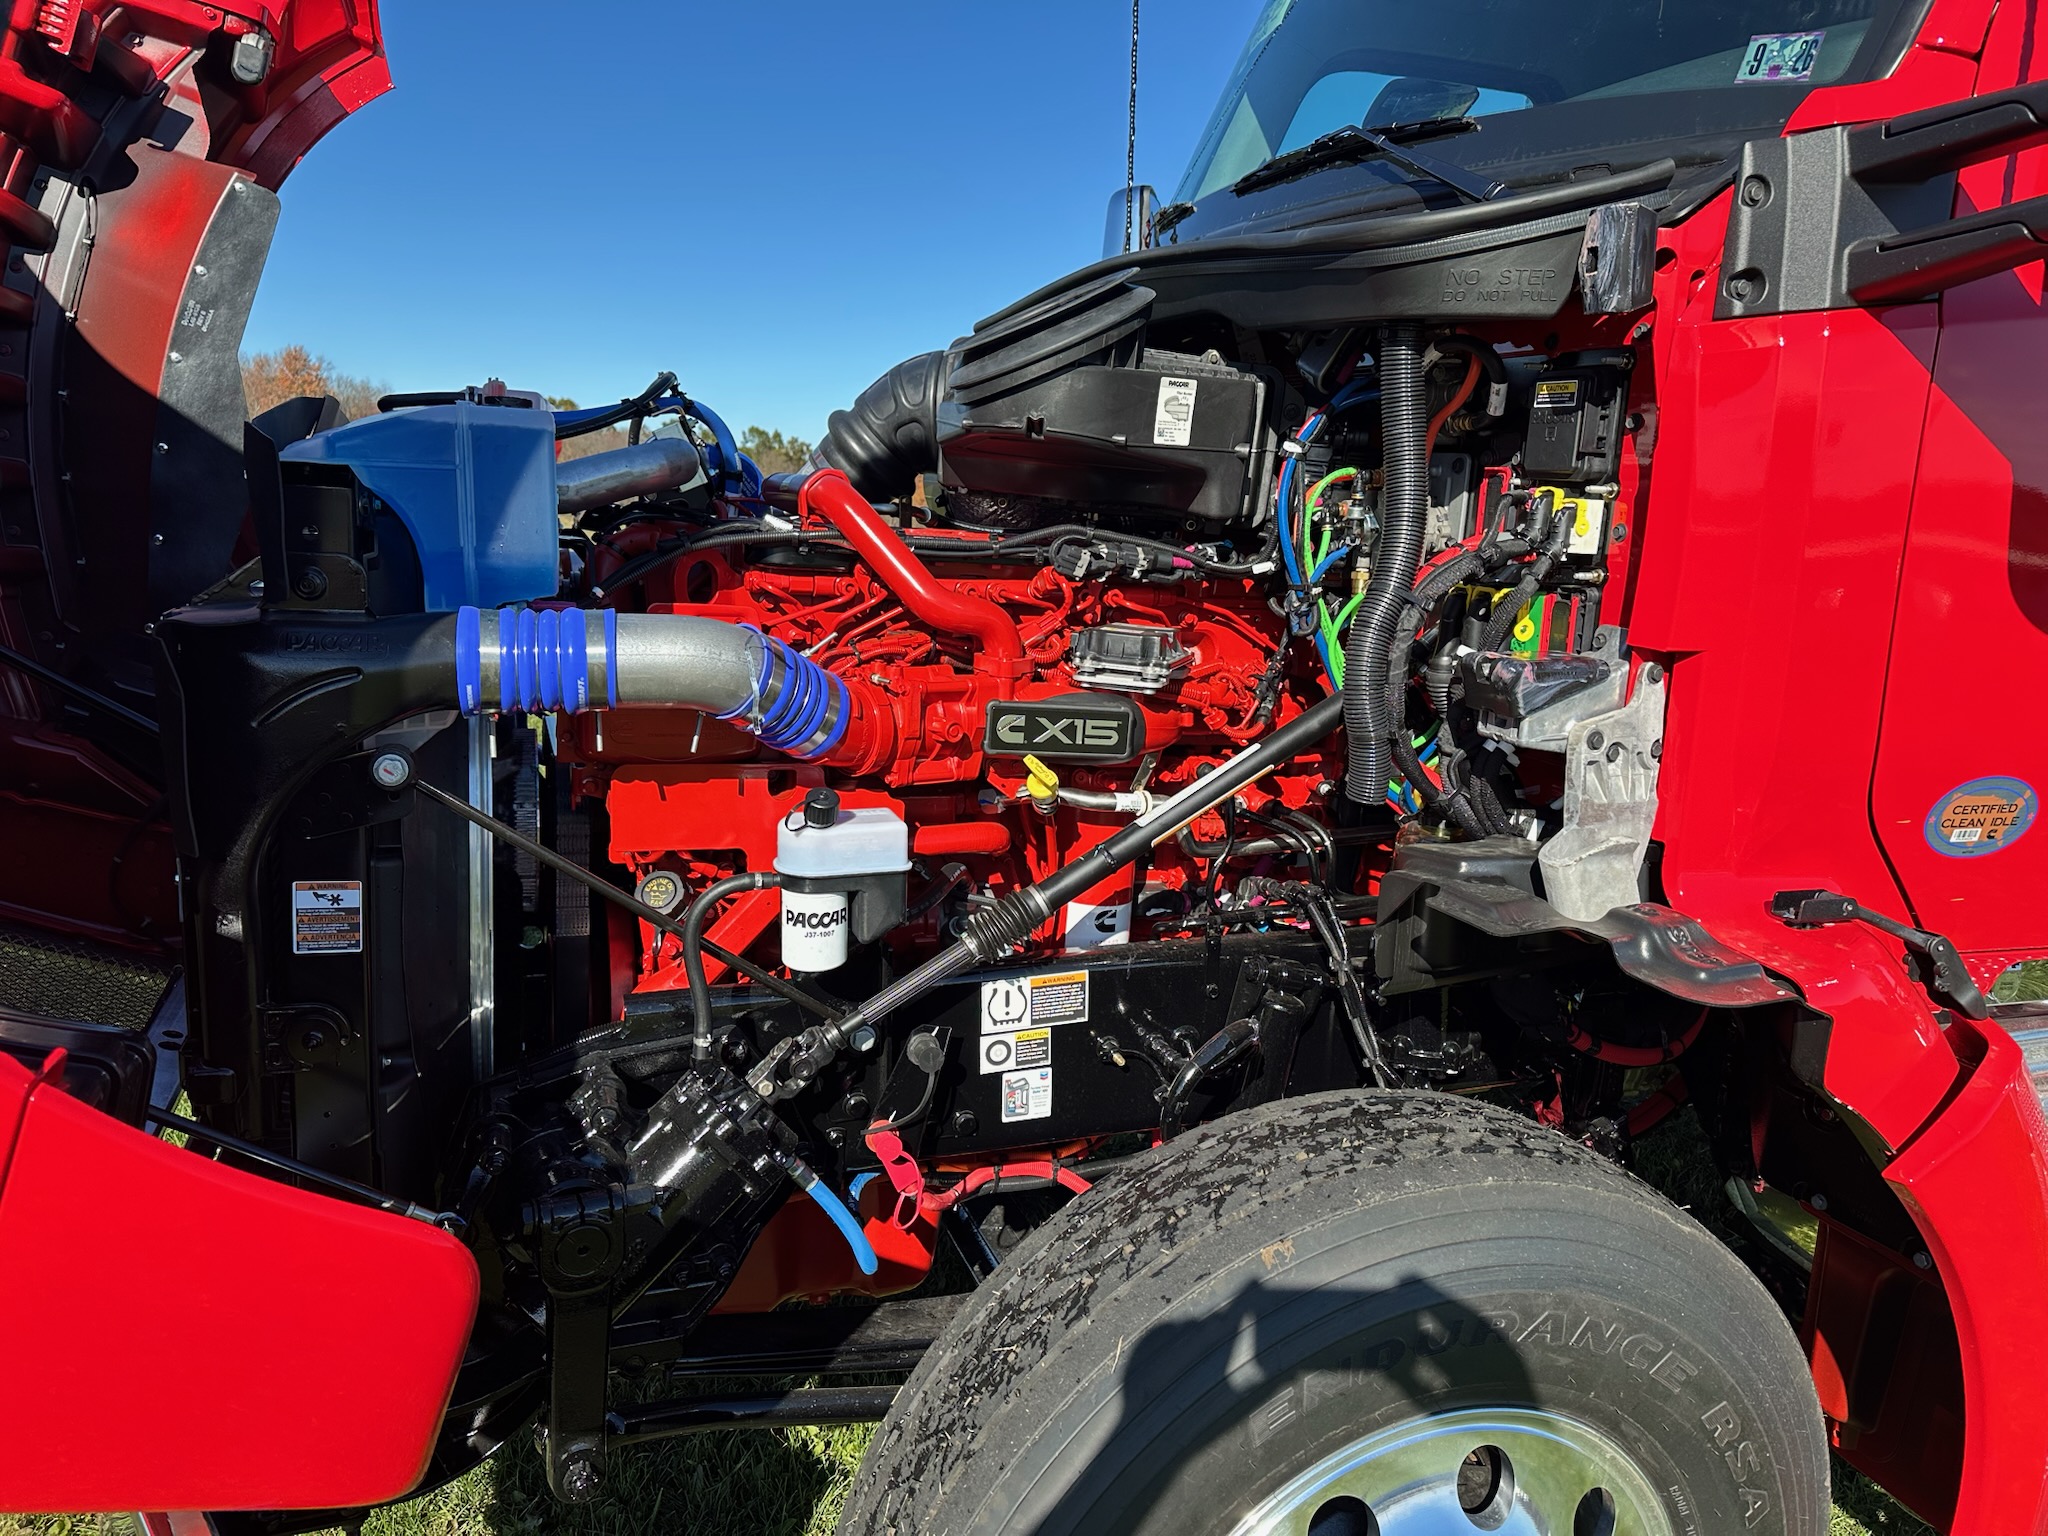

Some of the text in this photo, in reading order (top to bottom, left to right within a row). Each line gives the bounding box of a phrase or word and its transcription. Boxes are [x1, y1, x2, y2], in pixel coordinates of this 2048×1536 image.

[1748, 39, 1819, 75] 9 26
[1446, 268, 1557, 286] NO STEP
[1442, 290, 1558, 302] DO NOT PULL
[1546, 384, 1570, 392] CAUTION
[286, 631, 386, 653] PACCAR
[1033, 716, 1119, 746] X15
[1952, 803, 2019, 815] CERTIFIED
[1941, 816, 2020, 828] CLEAN IDLE
[316, 882, 349, 890] WARNING
[786, 907, 847, 929] PACCAR
[804, 930, 835, 938] J37-1007
[1047, 975, 1075, 984] WARNING
[1021, 1031, 1049, 1040] CAUTION
[1248, 1310, 1699, 1449] ENDURANCE
[1700, 1400, 1771, 1530] RSA
[1669, 1485, 1690, 1517] RADIAL
